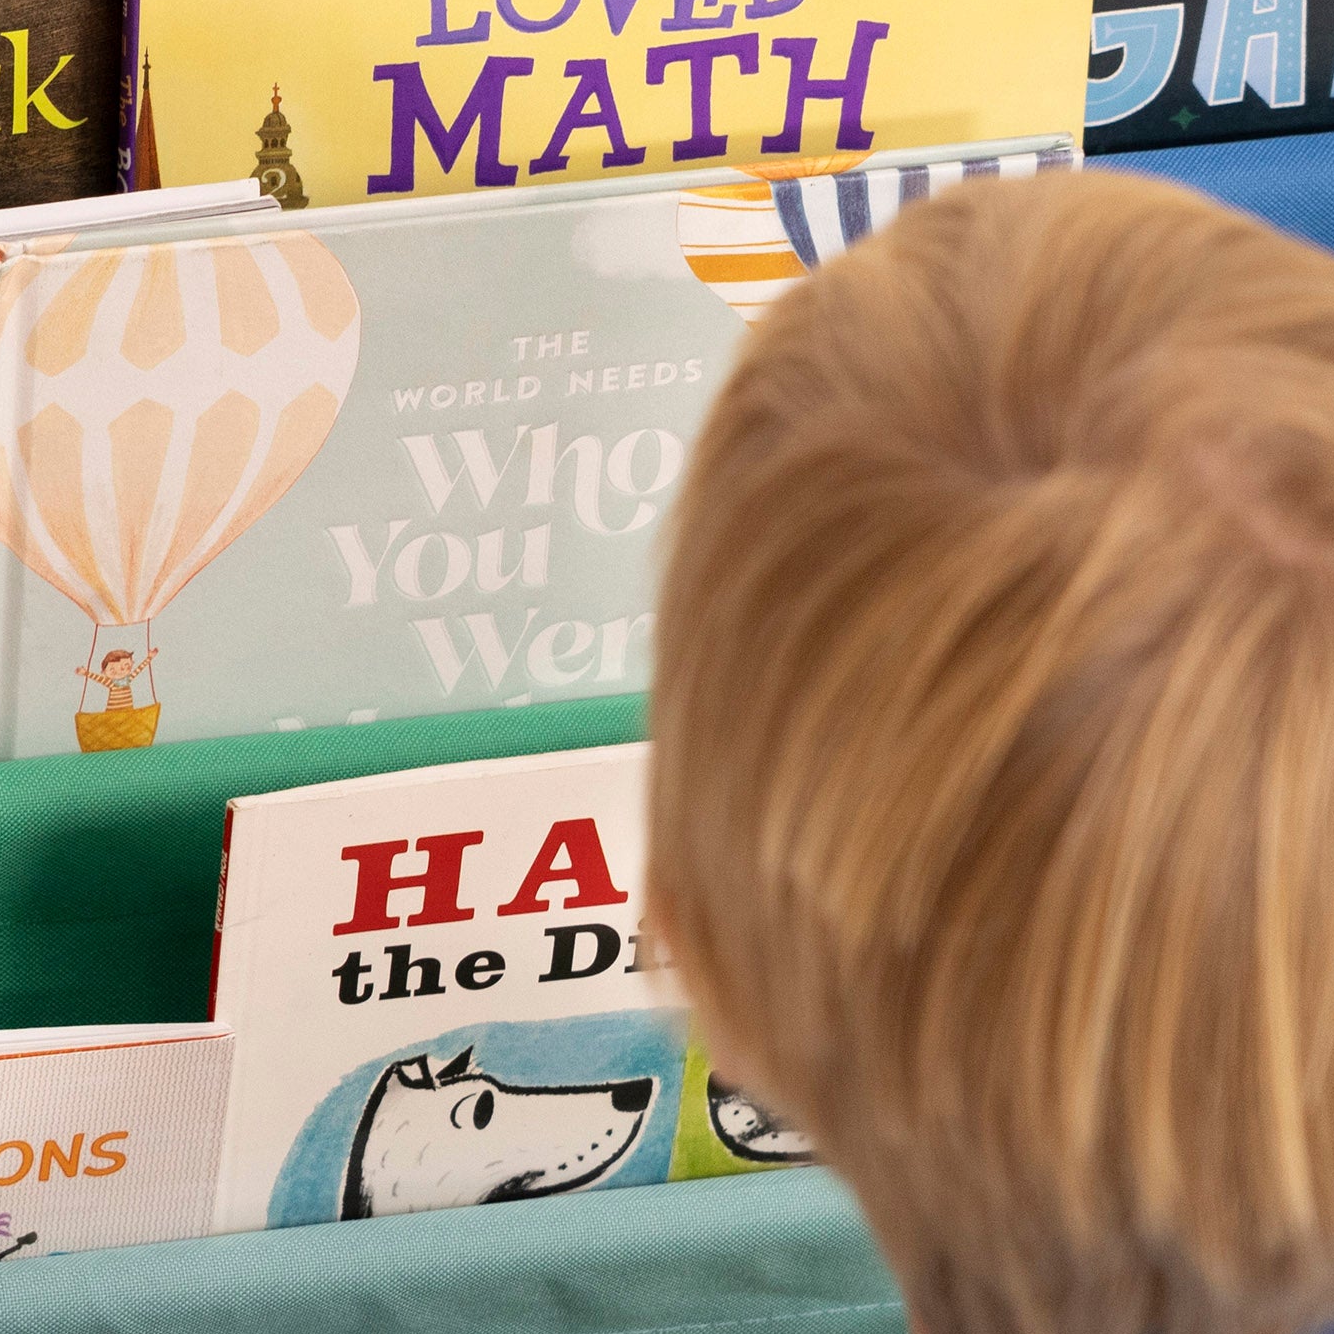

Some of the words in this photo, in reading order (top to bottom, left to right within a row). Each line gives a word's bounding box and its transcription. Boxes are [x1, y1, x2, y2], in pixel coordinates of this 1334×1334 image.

[366, 19, 891, 196] MATH
[512, 330, 591, 362] THE
[392, 375, 543, 414] WORLD
[565, 358, 704, 397] NEEDS
[396, 421, 685, 537] Who
[323, 518, 552, 607] You
[331, 943, 506, 1005] the
